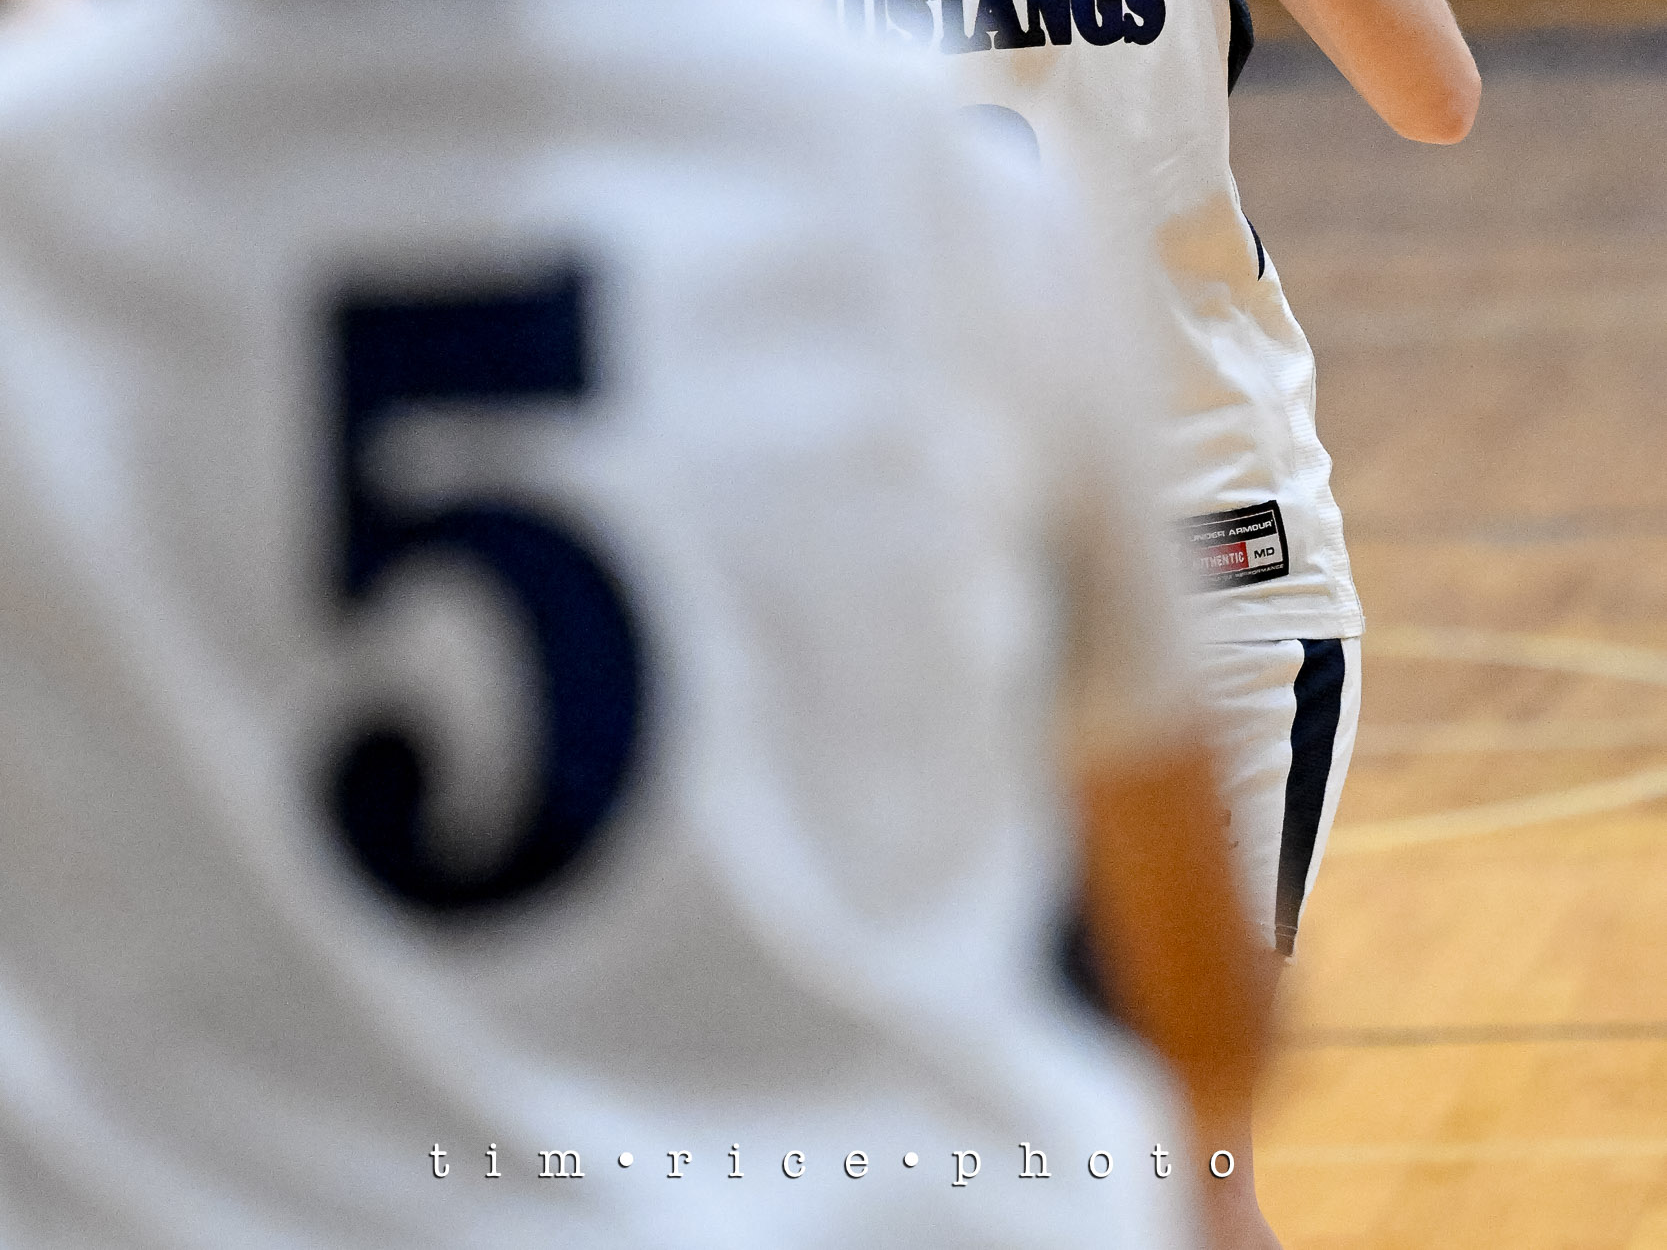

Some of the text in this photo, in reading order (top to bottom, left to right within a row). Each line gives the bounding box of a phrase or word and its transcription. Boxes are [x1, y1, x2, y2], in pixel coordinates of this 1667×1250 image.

[1228, 519, 1273, 537] ARMOUR
[1194, 551, 1245, 569] UTHENTIC
[1253, 546, 1275, 560] MD
[326, 270, 648, 918] 5
